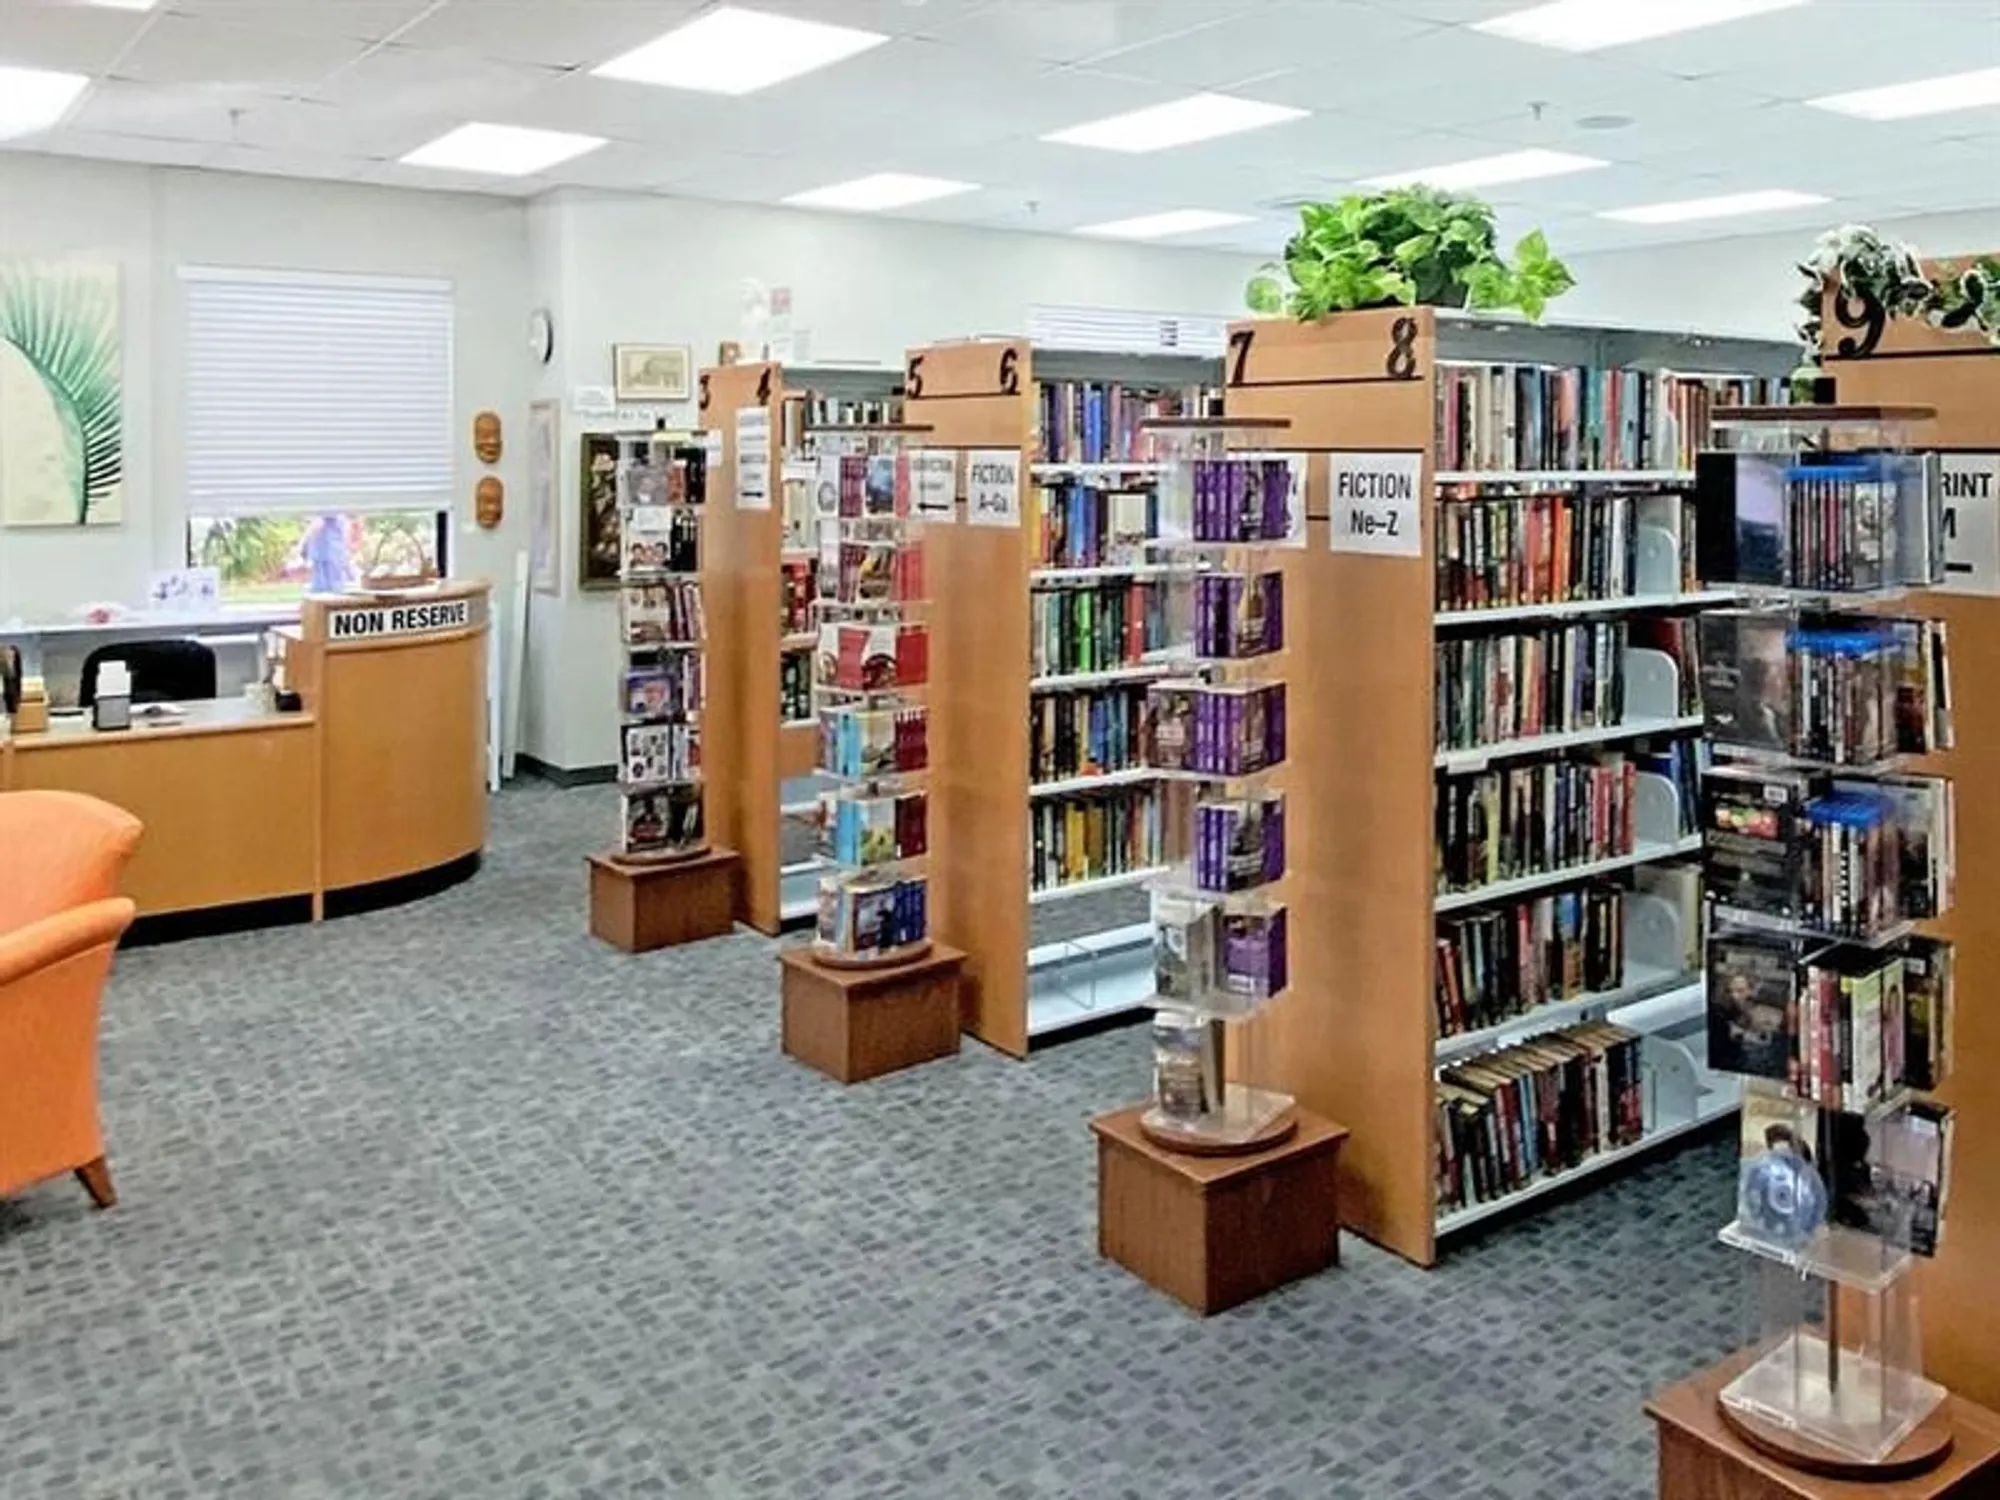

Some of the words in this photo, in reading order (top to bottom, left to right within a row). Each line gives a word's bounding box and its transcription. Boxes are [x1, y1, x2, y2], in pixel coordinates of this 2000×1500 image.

[1835, 279, 1886, 357] 9
[1230, 330, 1255, 386] 7
[1386, 317, 1418, 378] 8
[756, 367, 771, 406] 4
[907, 355, 924, 399] 5
[1000, 348, 1018, 395] 6
[699, 374, 711, 411] 3
[971, 464, 1014, 485] FICTION
[1338, 472, 1412, 500] FICTION
[1941, 472, 1993, 498] RINT
[334, 611, 384, 635] NON
[391, 602, 465, 631] RESERVE
